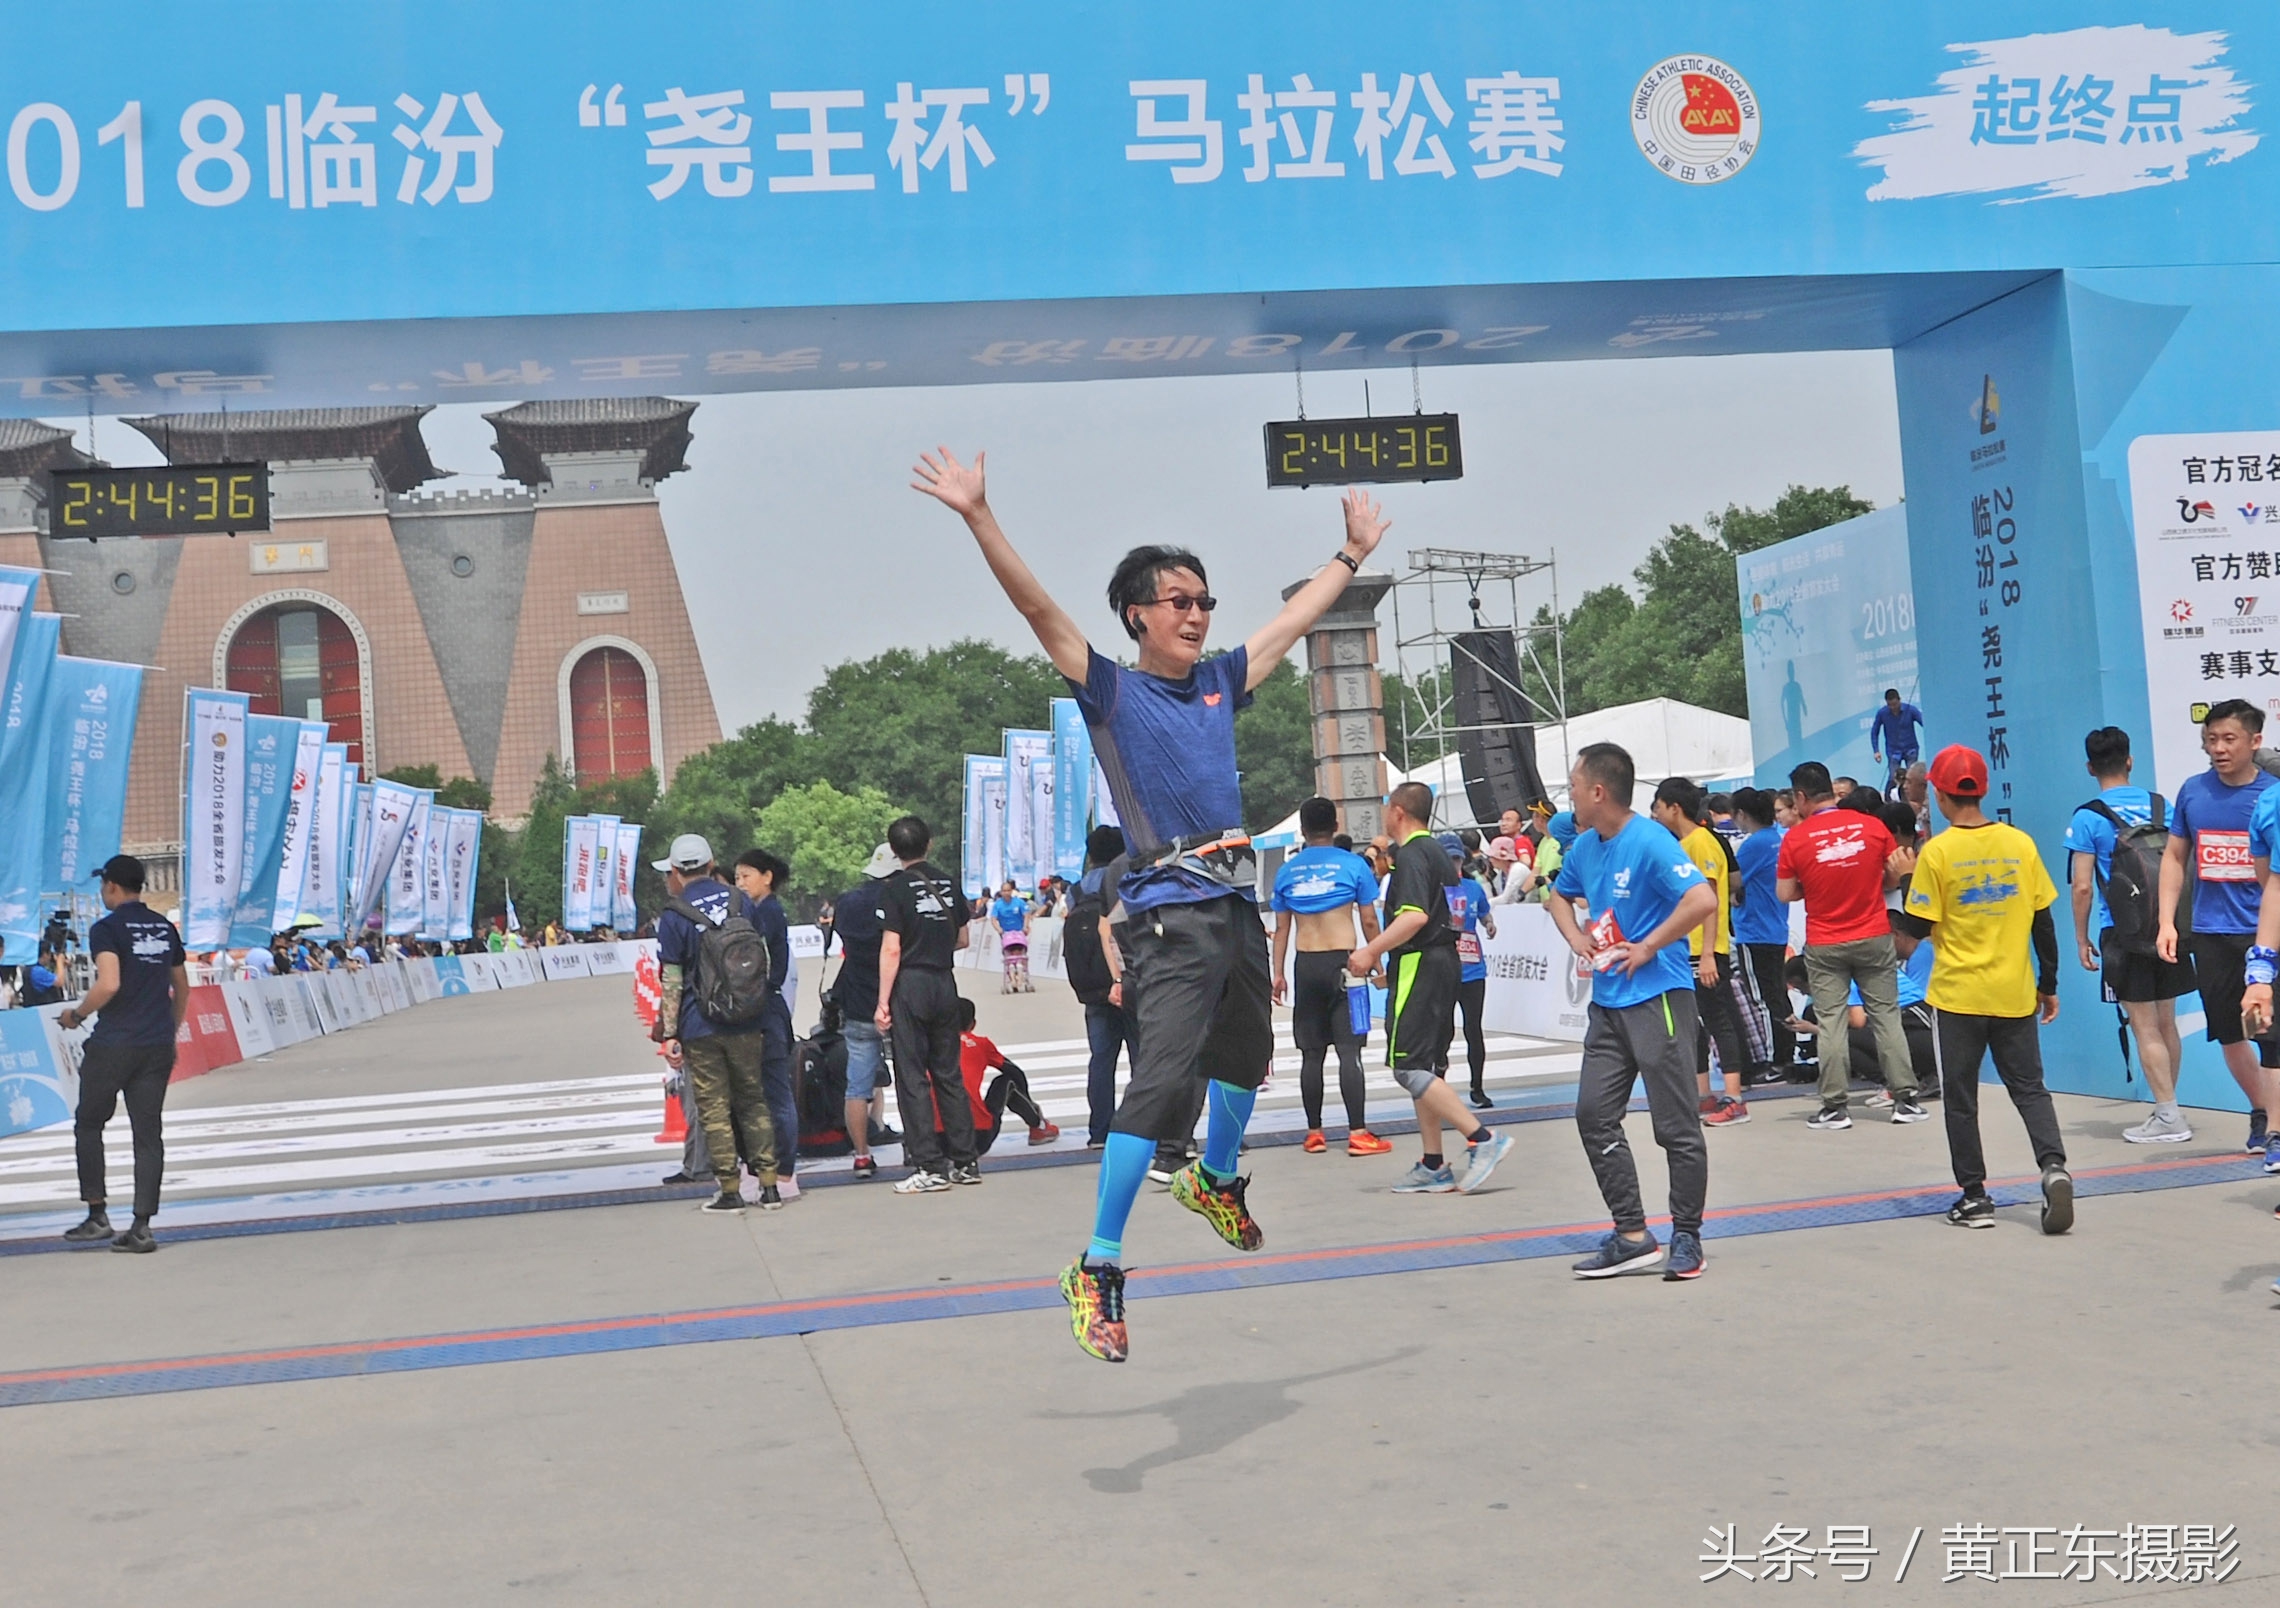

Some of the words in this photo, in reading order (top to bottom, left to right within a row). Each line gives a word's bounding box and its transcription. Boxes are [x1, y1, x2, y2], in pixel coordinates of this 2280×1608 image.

[1635, 76, 1659, 120] CHINESE
[1656, 59, 1703, 81] ATHLETIC
[1705, 63, 1756, 119] ASSOCIATION
[1125, 71, 1567, 185] 马拉松赛
[1969, 73, 2187, 147] 起终点
[1643, 140, 1754, 180] 中国田径协会
[1282, 426, 1449, 474] 2:44:36
[2183, 453, 2280, 484] 官方冠名
[63, 475, 255, 526] 2:44:36
[1994, 486, 2021, 607] 2018
[2191, 551, 2280, 582] 官方赞
[2212, 618, 2246, 627] FITNESS
[2246, 616, 2279, 626] CENTER
[2201, 649, 2280, 681] 赛事支
[89, 720, 107, 760] 2018
[261, 763, 277, 795] 2018
[2202, 846, 2255, 864] C394
